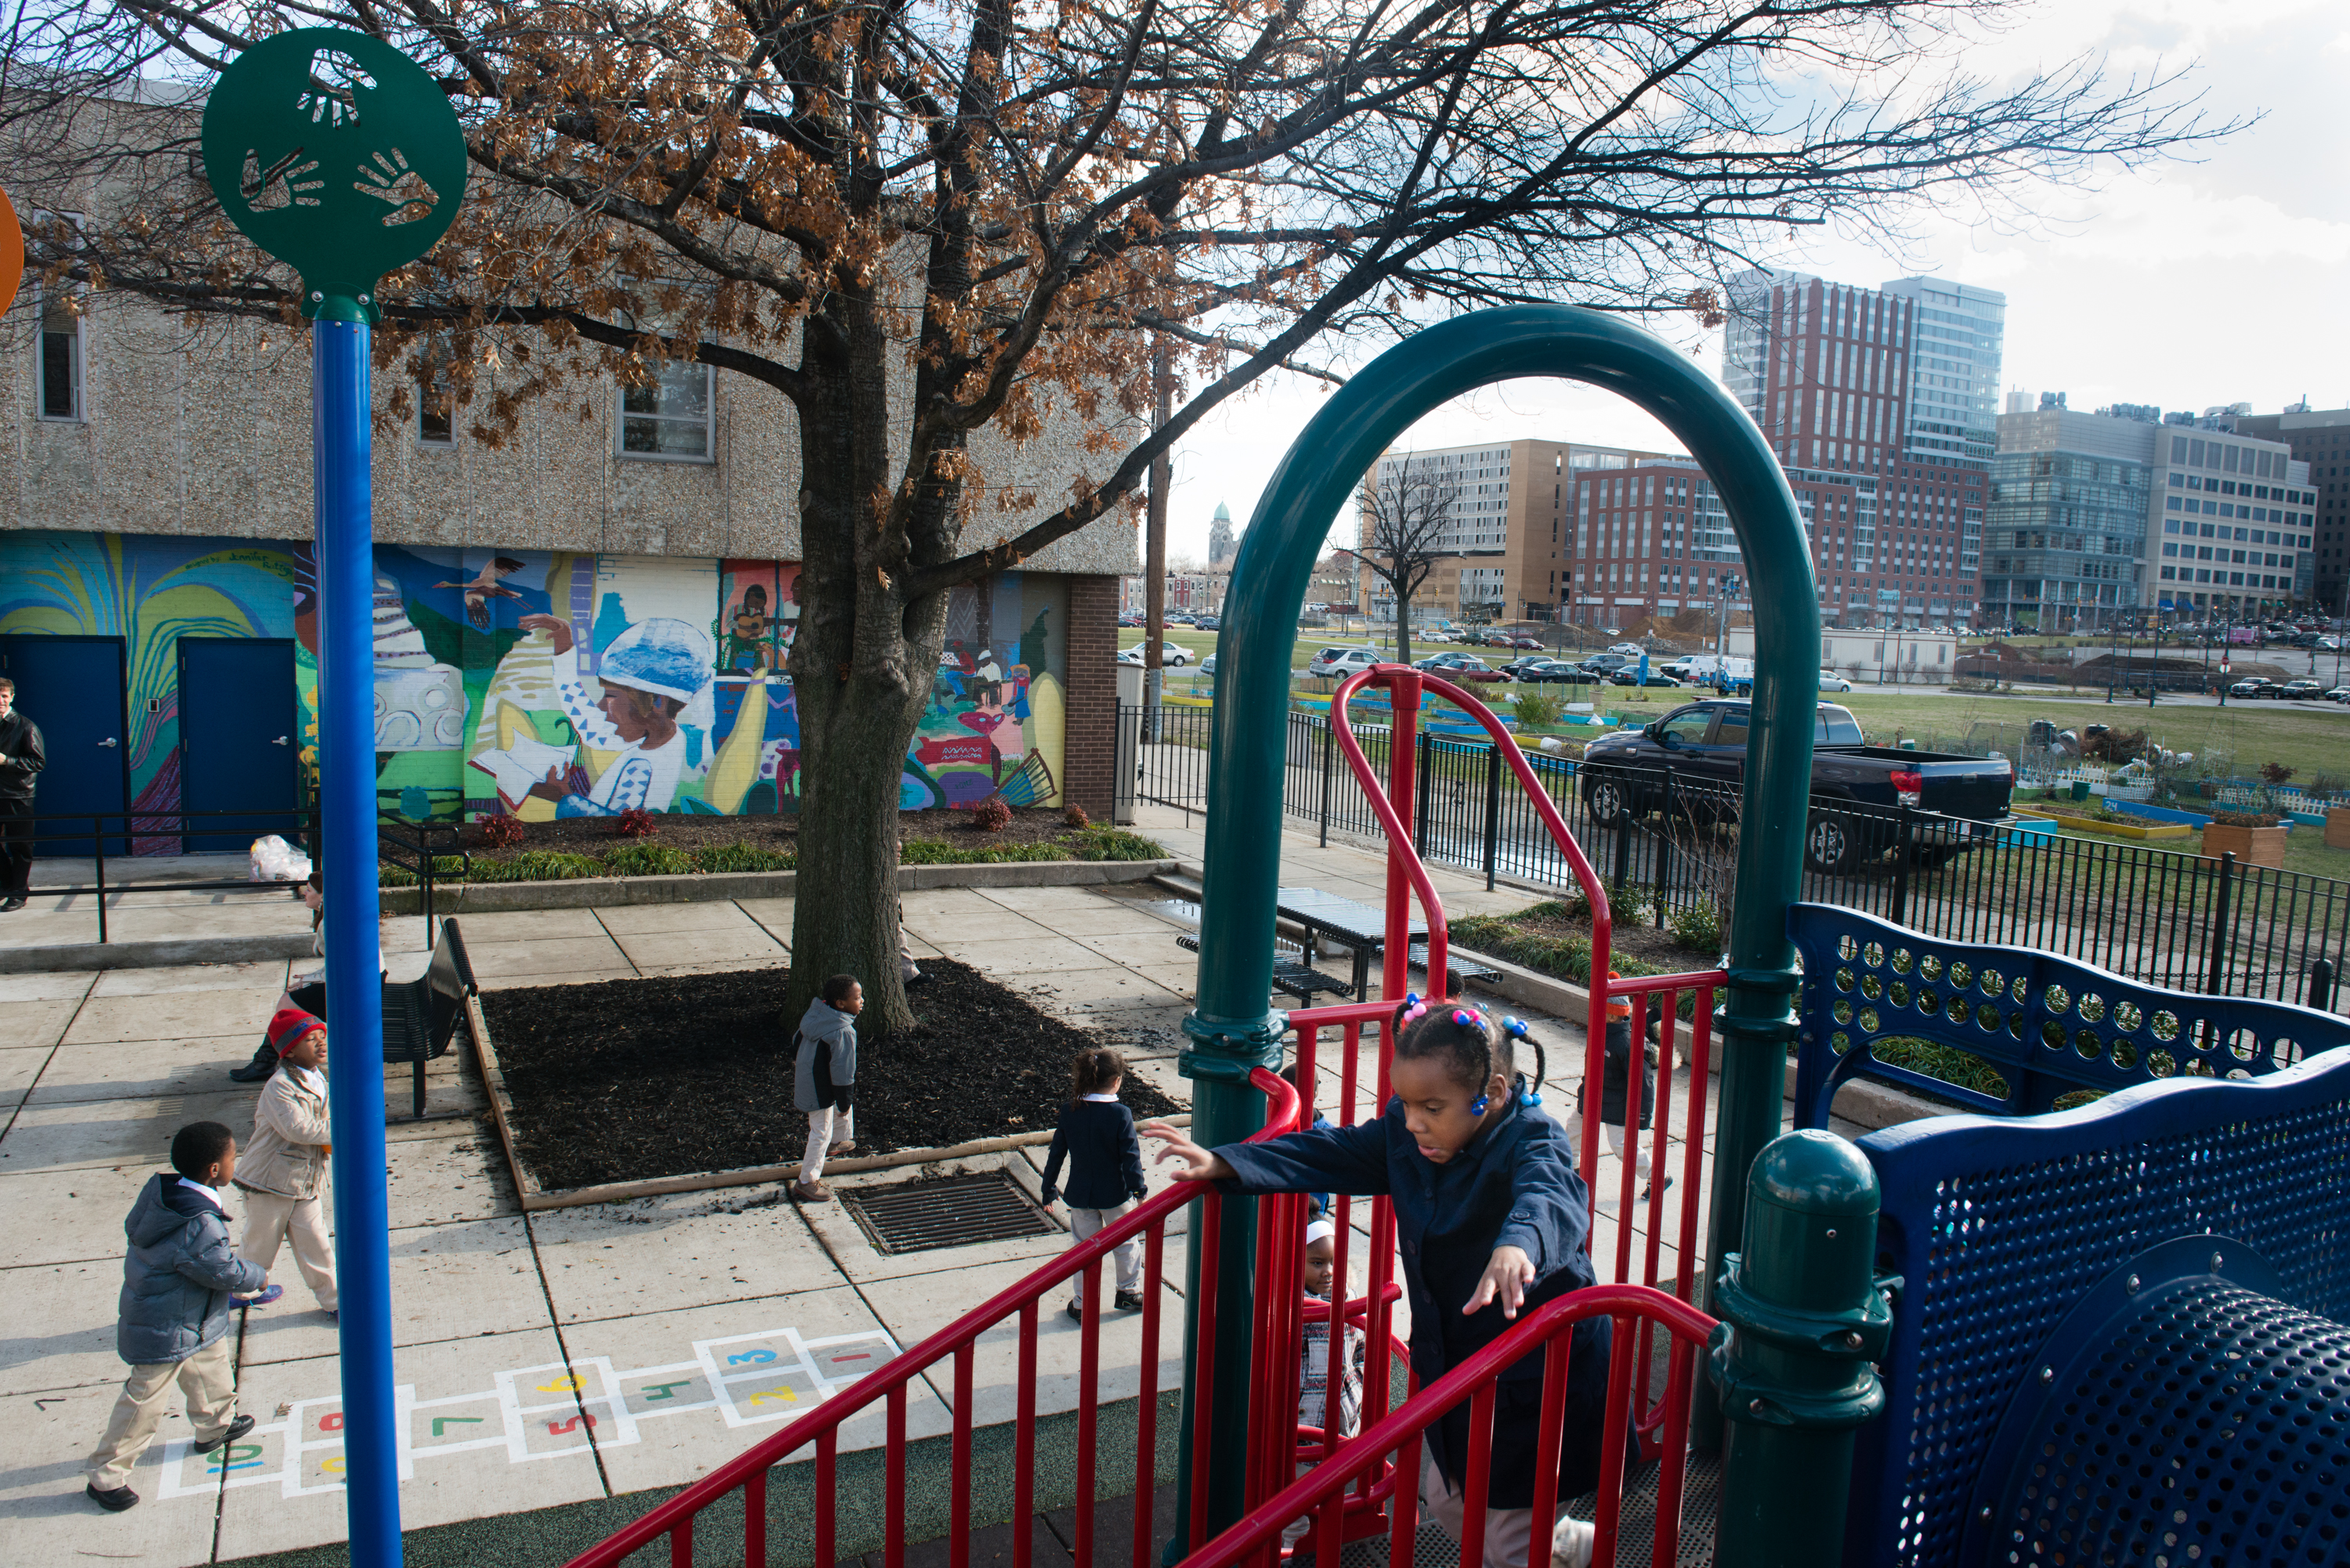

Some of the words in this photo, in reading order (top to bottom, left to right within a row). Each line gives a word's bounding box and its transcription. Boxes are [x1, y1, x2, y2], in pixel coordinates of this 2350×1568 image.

[2105, 800, 2118, 811] 24
[727, 1349, 778, 1366] 3
[536, 1374, 588, 1393] 6
[640, 1380, 691, 1401] 4
[749, 1385, 797, 1407] 2
[432, 1416, 484, 1437] 7
[548, 1414, 597, 1436] 5
[206, 1444, 265, 1475] 10
